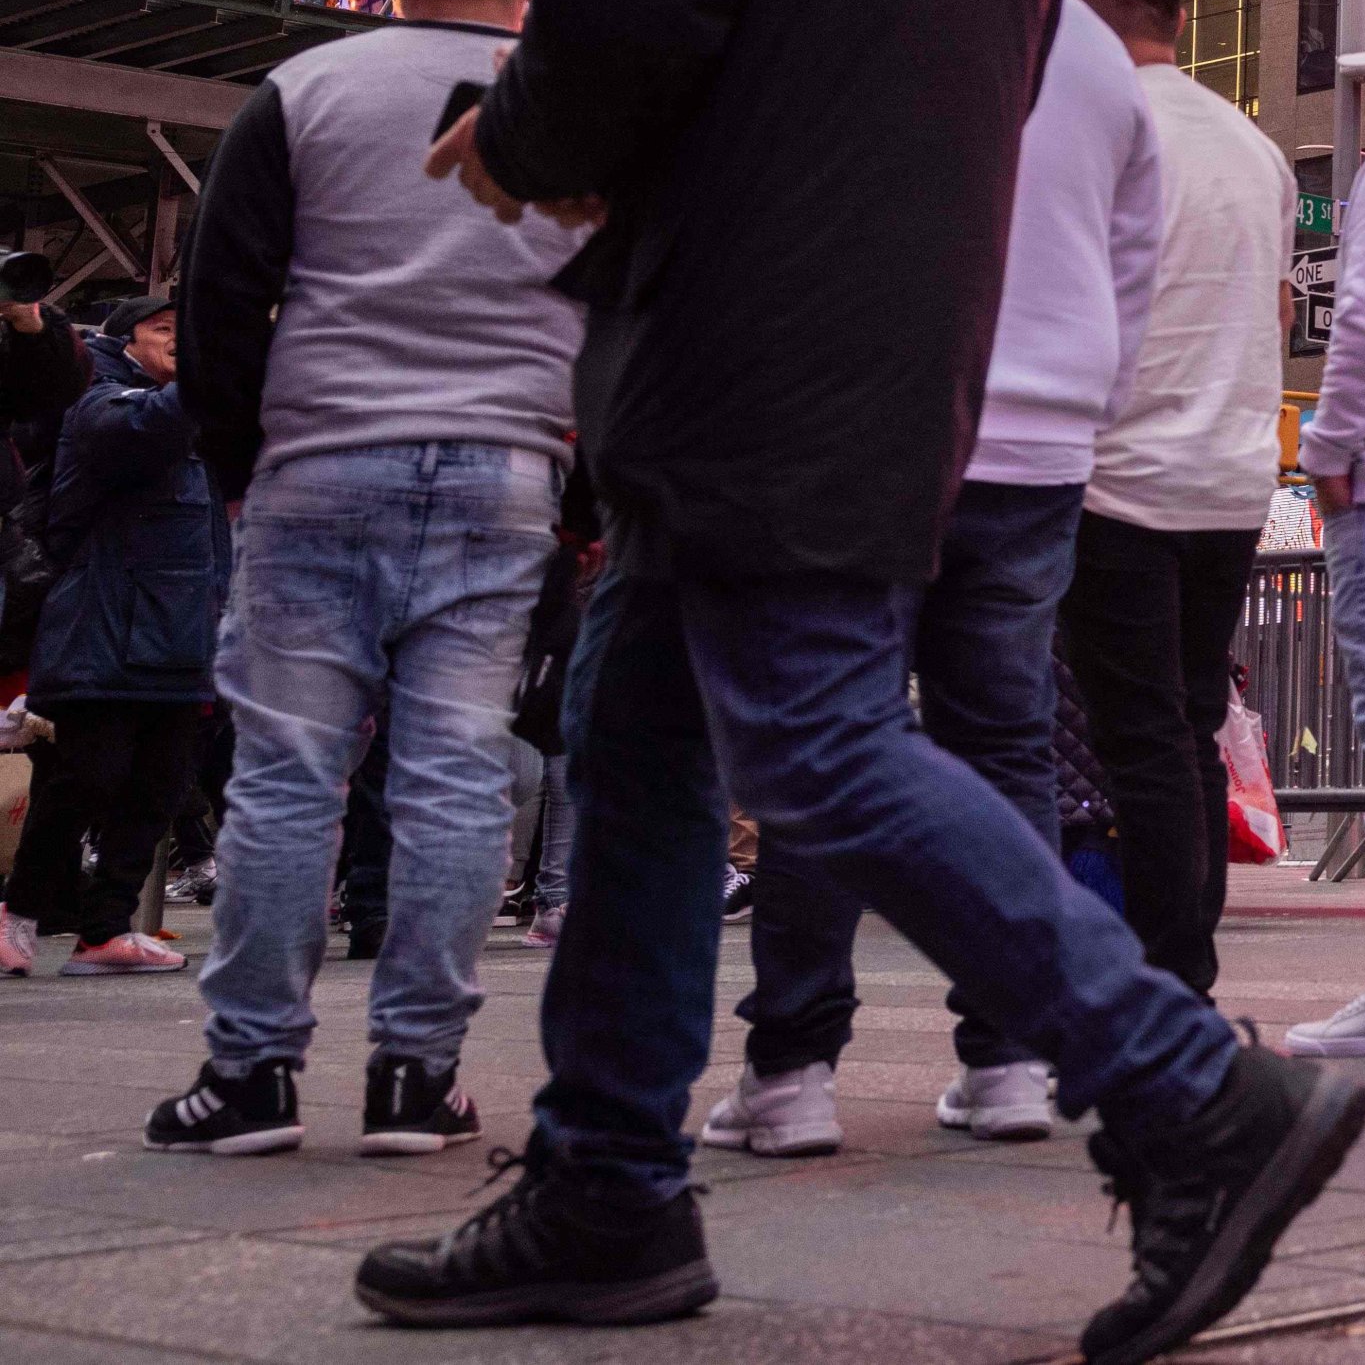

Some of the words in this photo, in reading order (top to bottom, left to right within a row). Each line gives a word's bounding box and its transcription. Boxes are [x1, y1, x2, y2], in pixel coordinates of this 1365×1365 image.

[1296, 198, 1314, 226] 43
[1321, 202, 1332, 220] St
[1296, 264, 1323, 285] ONE
